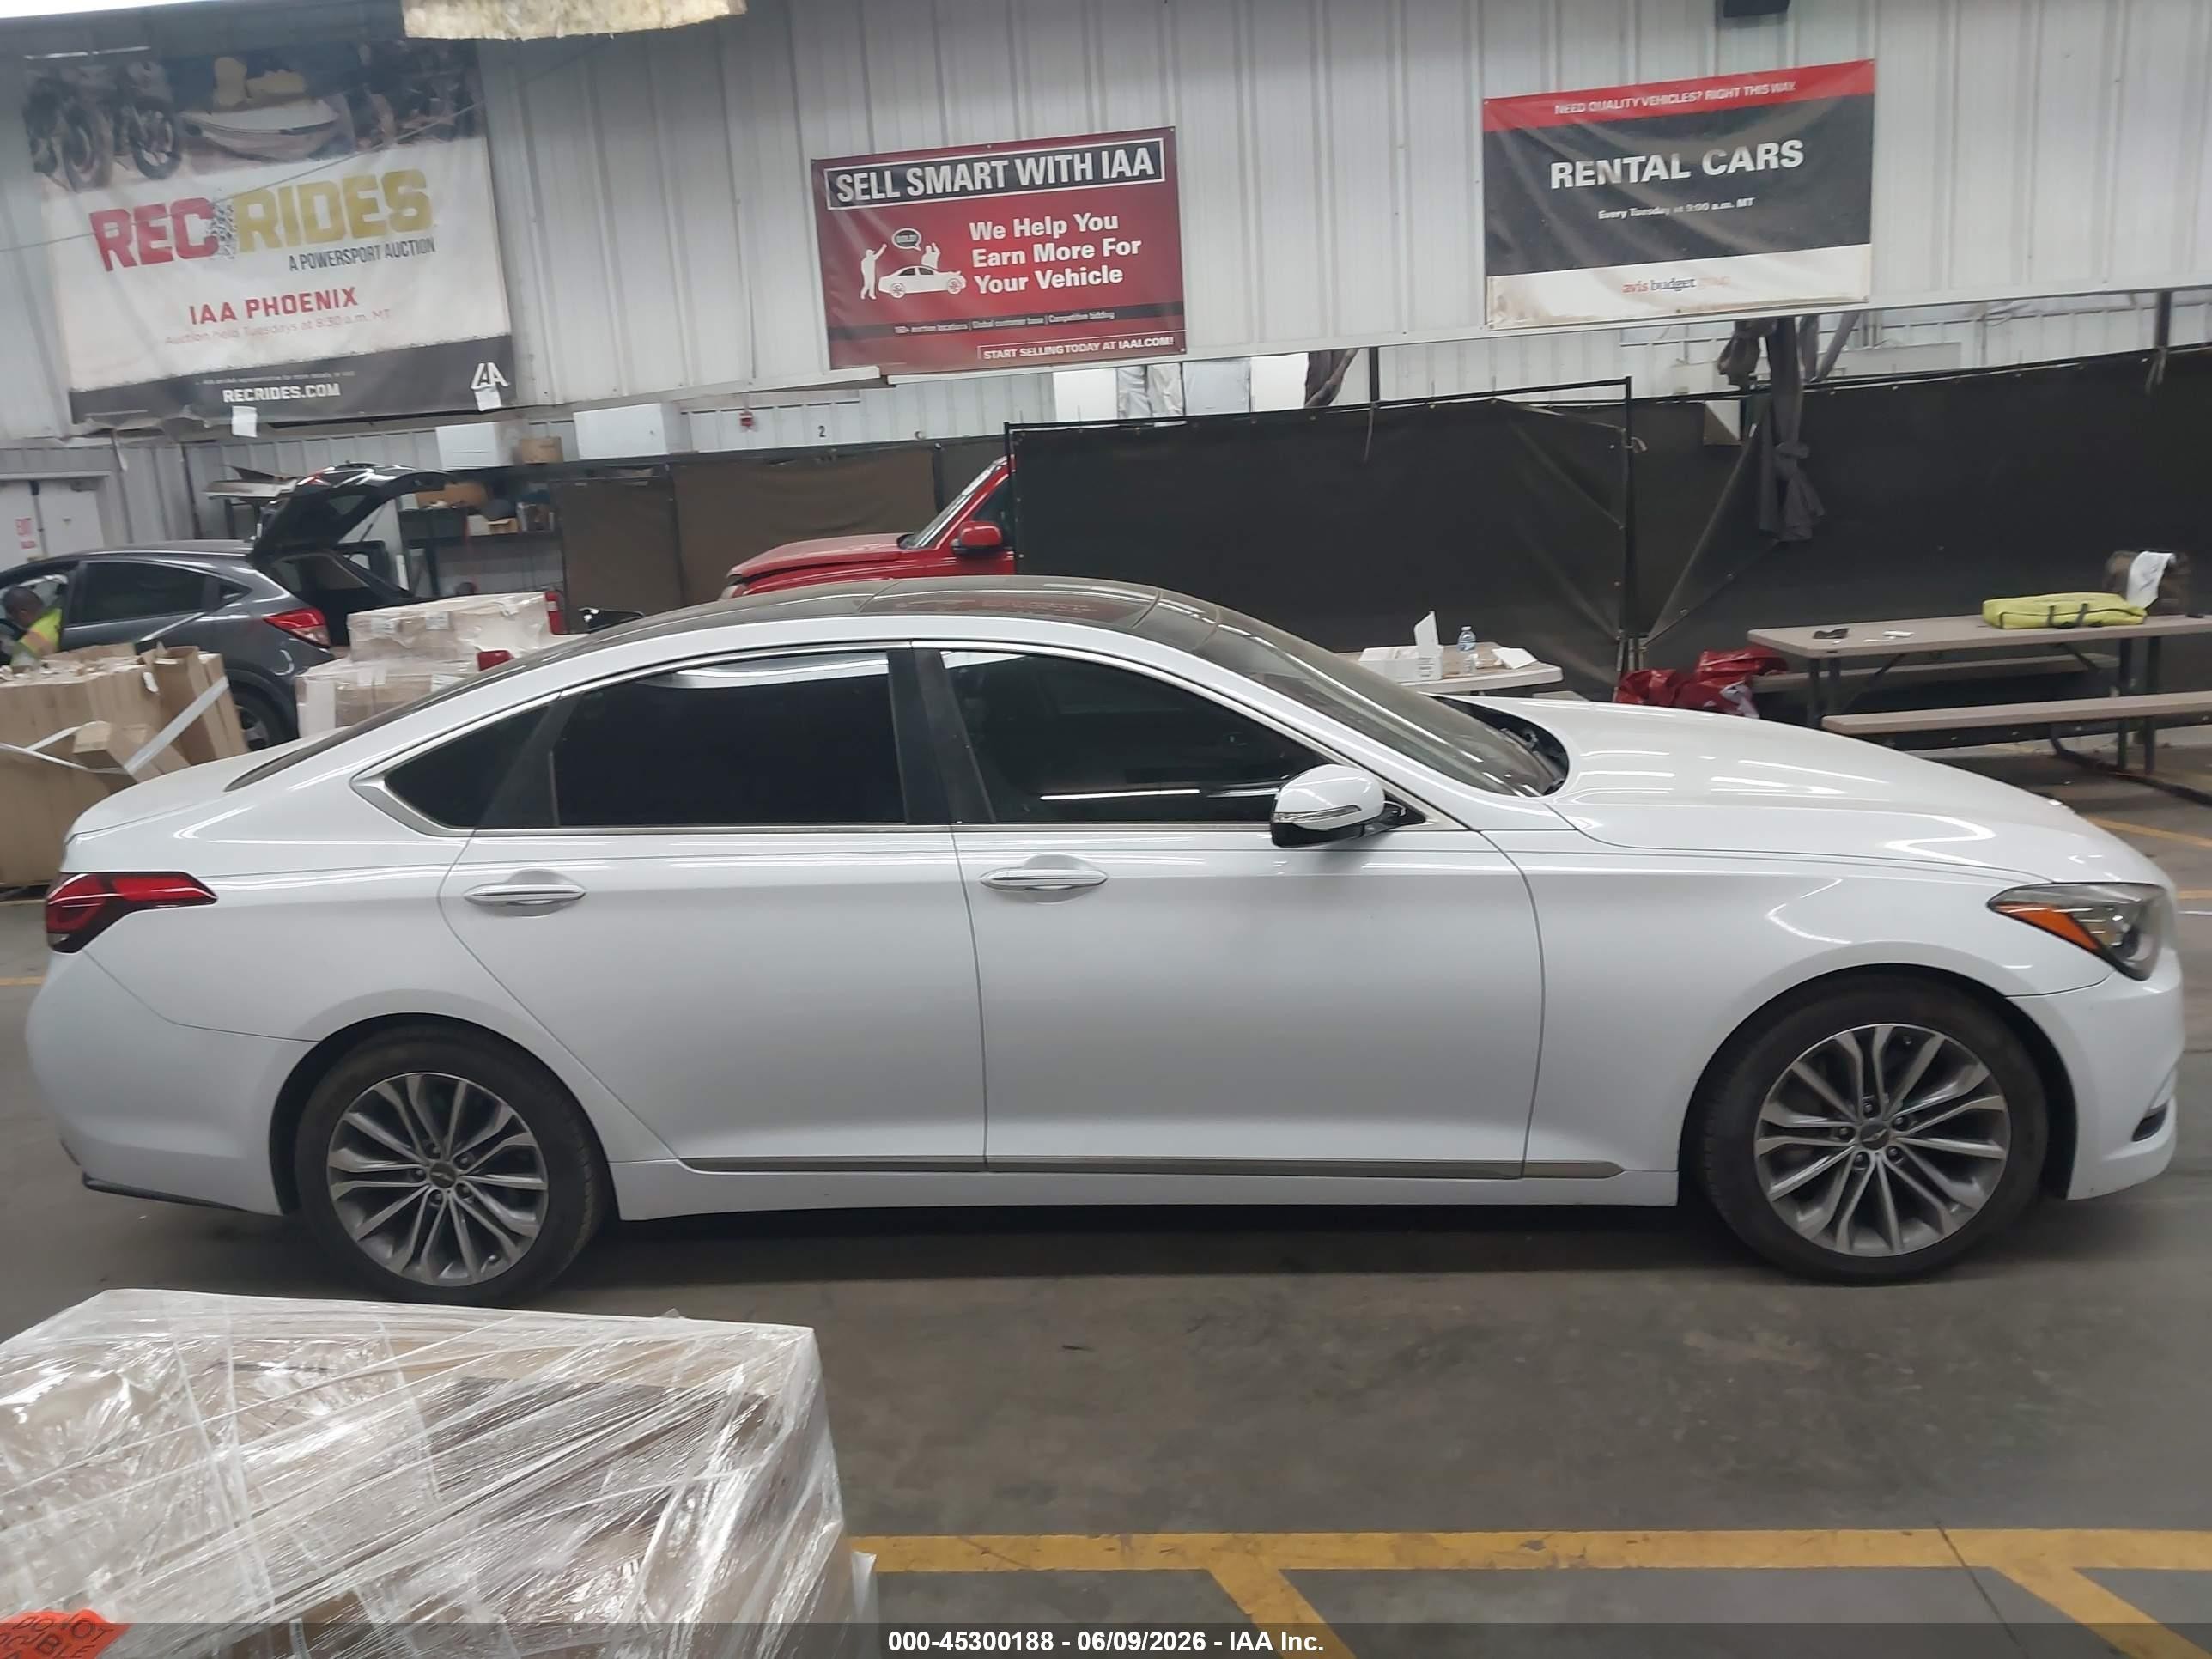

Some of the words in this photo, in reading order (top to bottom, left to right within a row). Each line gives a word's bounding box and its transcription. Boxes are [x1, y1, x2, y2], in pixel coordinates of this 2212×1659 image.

[1554, 102, 1586, 114] NEED
[1589, 99, 1640, 112] QUALITY
[1641, 91, 1703, 106] VEHICLES?
[1705, 88, 1741, 100] RIGHT
[1744, 85, 1769, 96] THIS
[836, 171, 901, 203] SELL
[907, 160, 1009, 196] SMART
[1014, 153, 1093, 186] WITH
[1101, 147, 1155, 179] IAA
[1550, 153, 1692, 189] RENTAL
[1702, 139, 1804, 176] CARS
[88, 198, 220, 272] REC
[233, 170, 432, 253] RIDES
[1598, 210, 1628, 219] Every
[1629, 206, 1671, 216] Tuesday
[1736, 198, 1755, 208] MT
[969, 221, 1006, 241] We
[1012, 216, 1068, 239] Help
[1073, 212, 1119, 232] You
[289, 255, 298, 271] A
[299, 244, 381, 270] POWERSPORT
[384, 237, 436, 259] AUCTION
[972, 248, 1026, 268] Earn
[1033, 243, 1096, 263] More
[1102, 237, 1142, 257] For
[974, 274, 1029, 294] Your
[1034, 265, 1123, 289] Vehicle
[1650, 277, 1697, 292] budget
[190, 302, 238, 325] IAA
[245, 286, 358, 319] PHOENIX
[983, 349, 1017, 359] START
[1019, 345, 1064, 357] SELLING
[1066, 343, 1100, 354] TODAY
[1103, 341, 1116, 351] AT
[222, 383, 341, 403] RECRIDES.COM
[818, 425, 827, 438] 2
